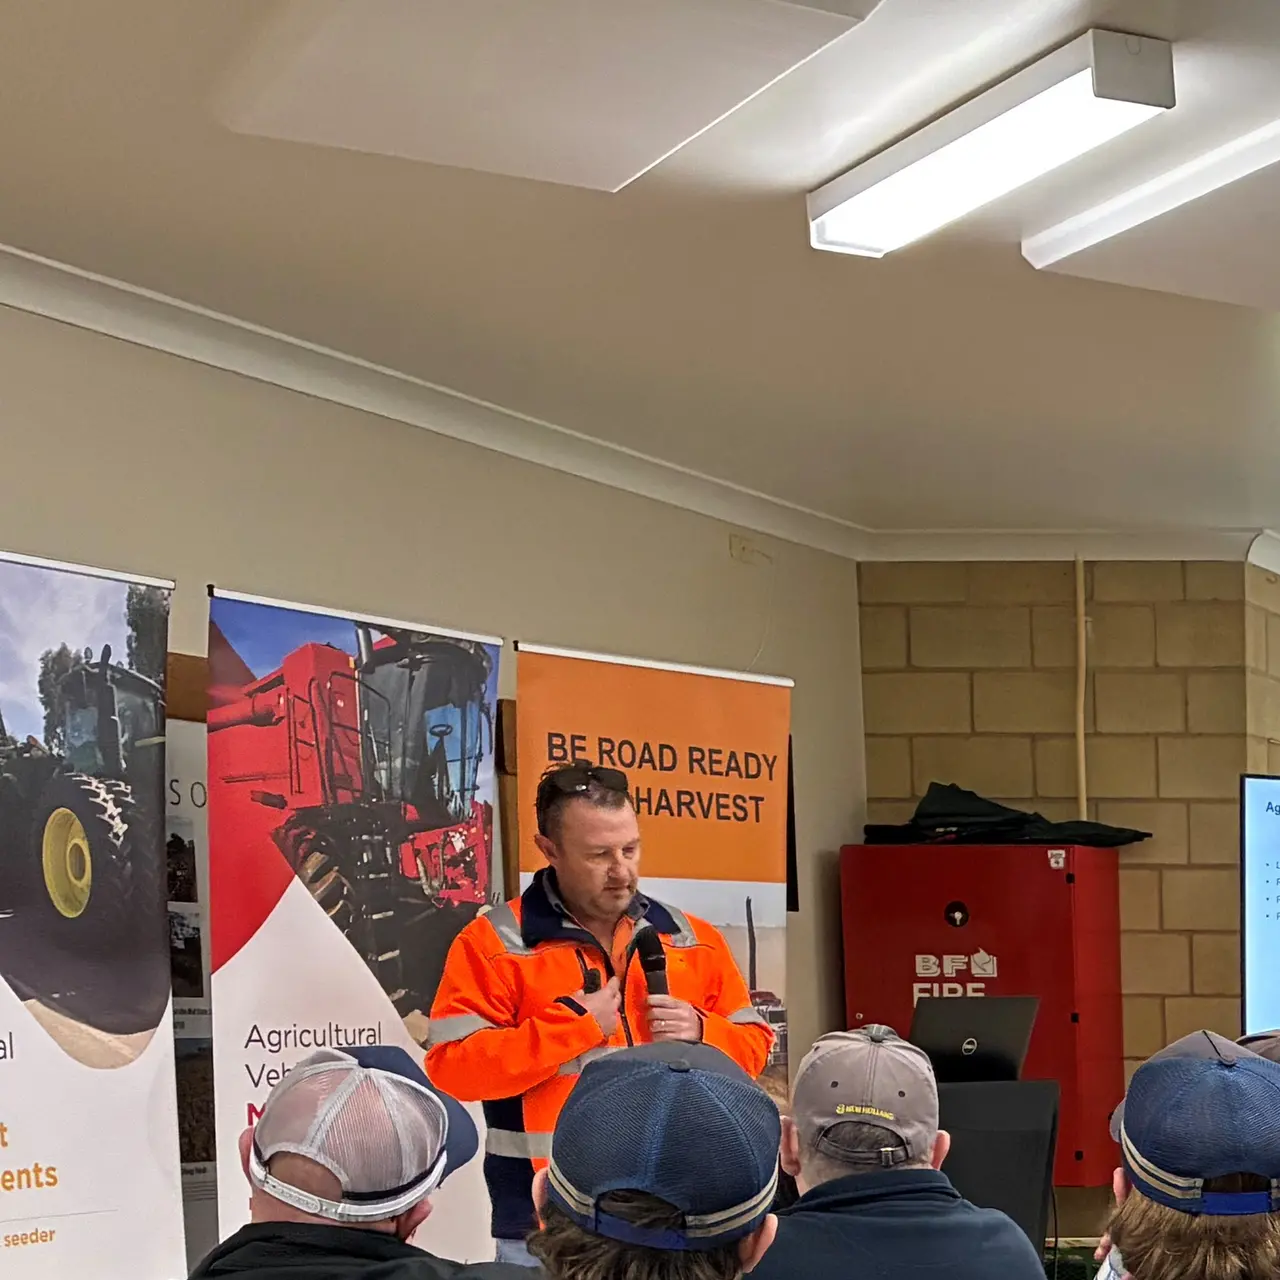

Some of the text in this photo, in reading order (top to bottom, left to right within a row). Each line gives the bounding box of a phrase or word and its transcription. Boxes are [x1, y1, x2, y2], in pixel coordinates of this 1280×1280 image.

[547, 732, 777, 782] BE ROAD READY
[635, 786, 764, 823] HARVEST
[244, 1021, 382, 1054] Agricultural
[1, 1162, 58, 1191] ents
[4, 1228, 55, 1247] seeder
